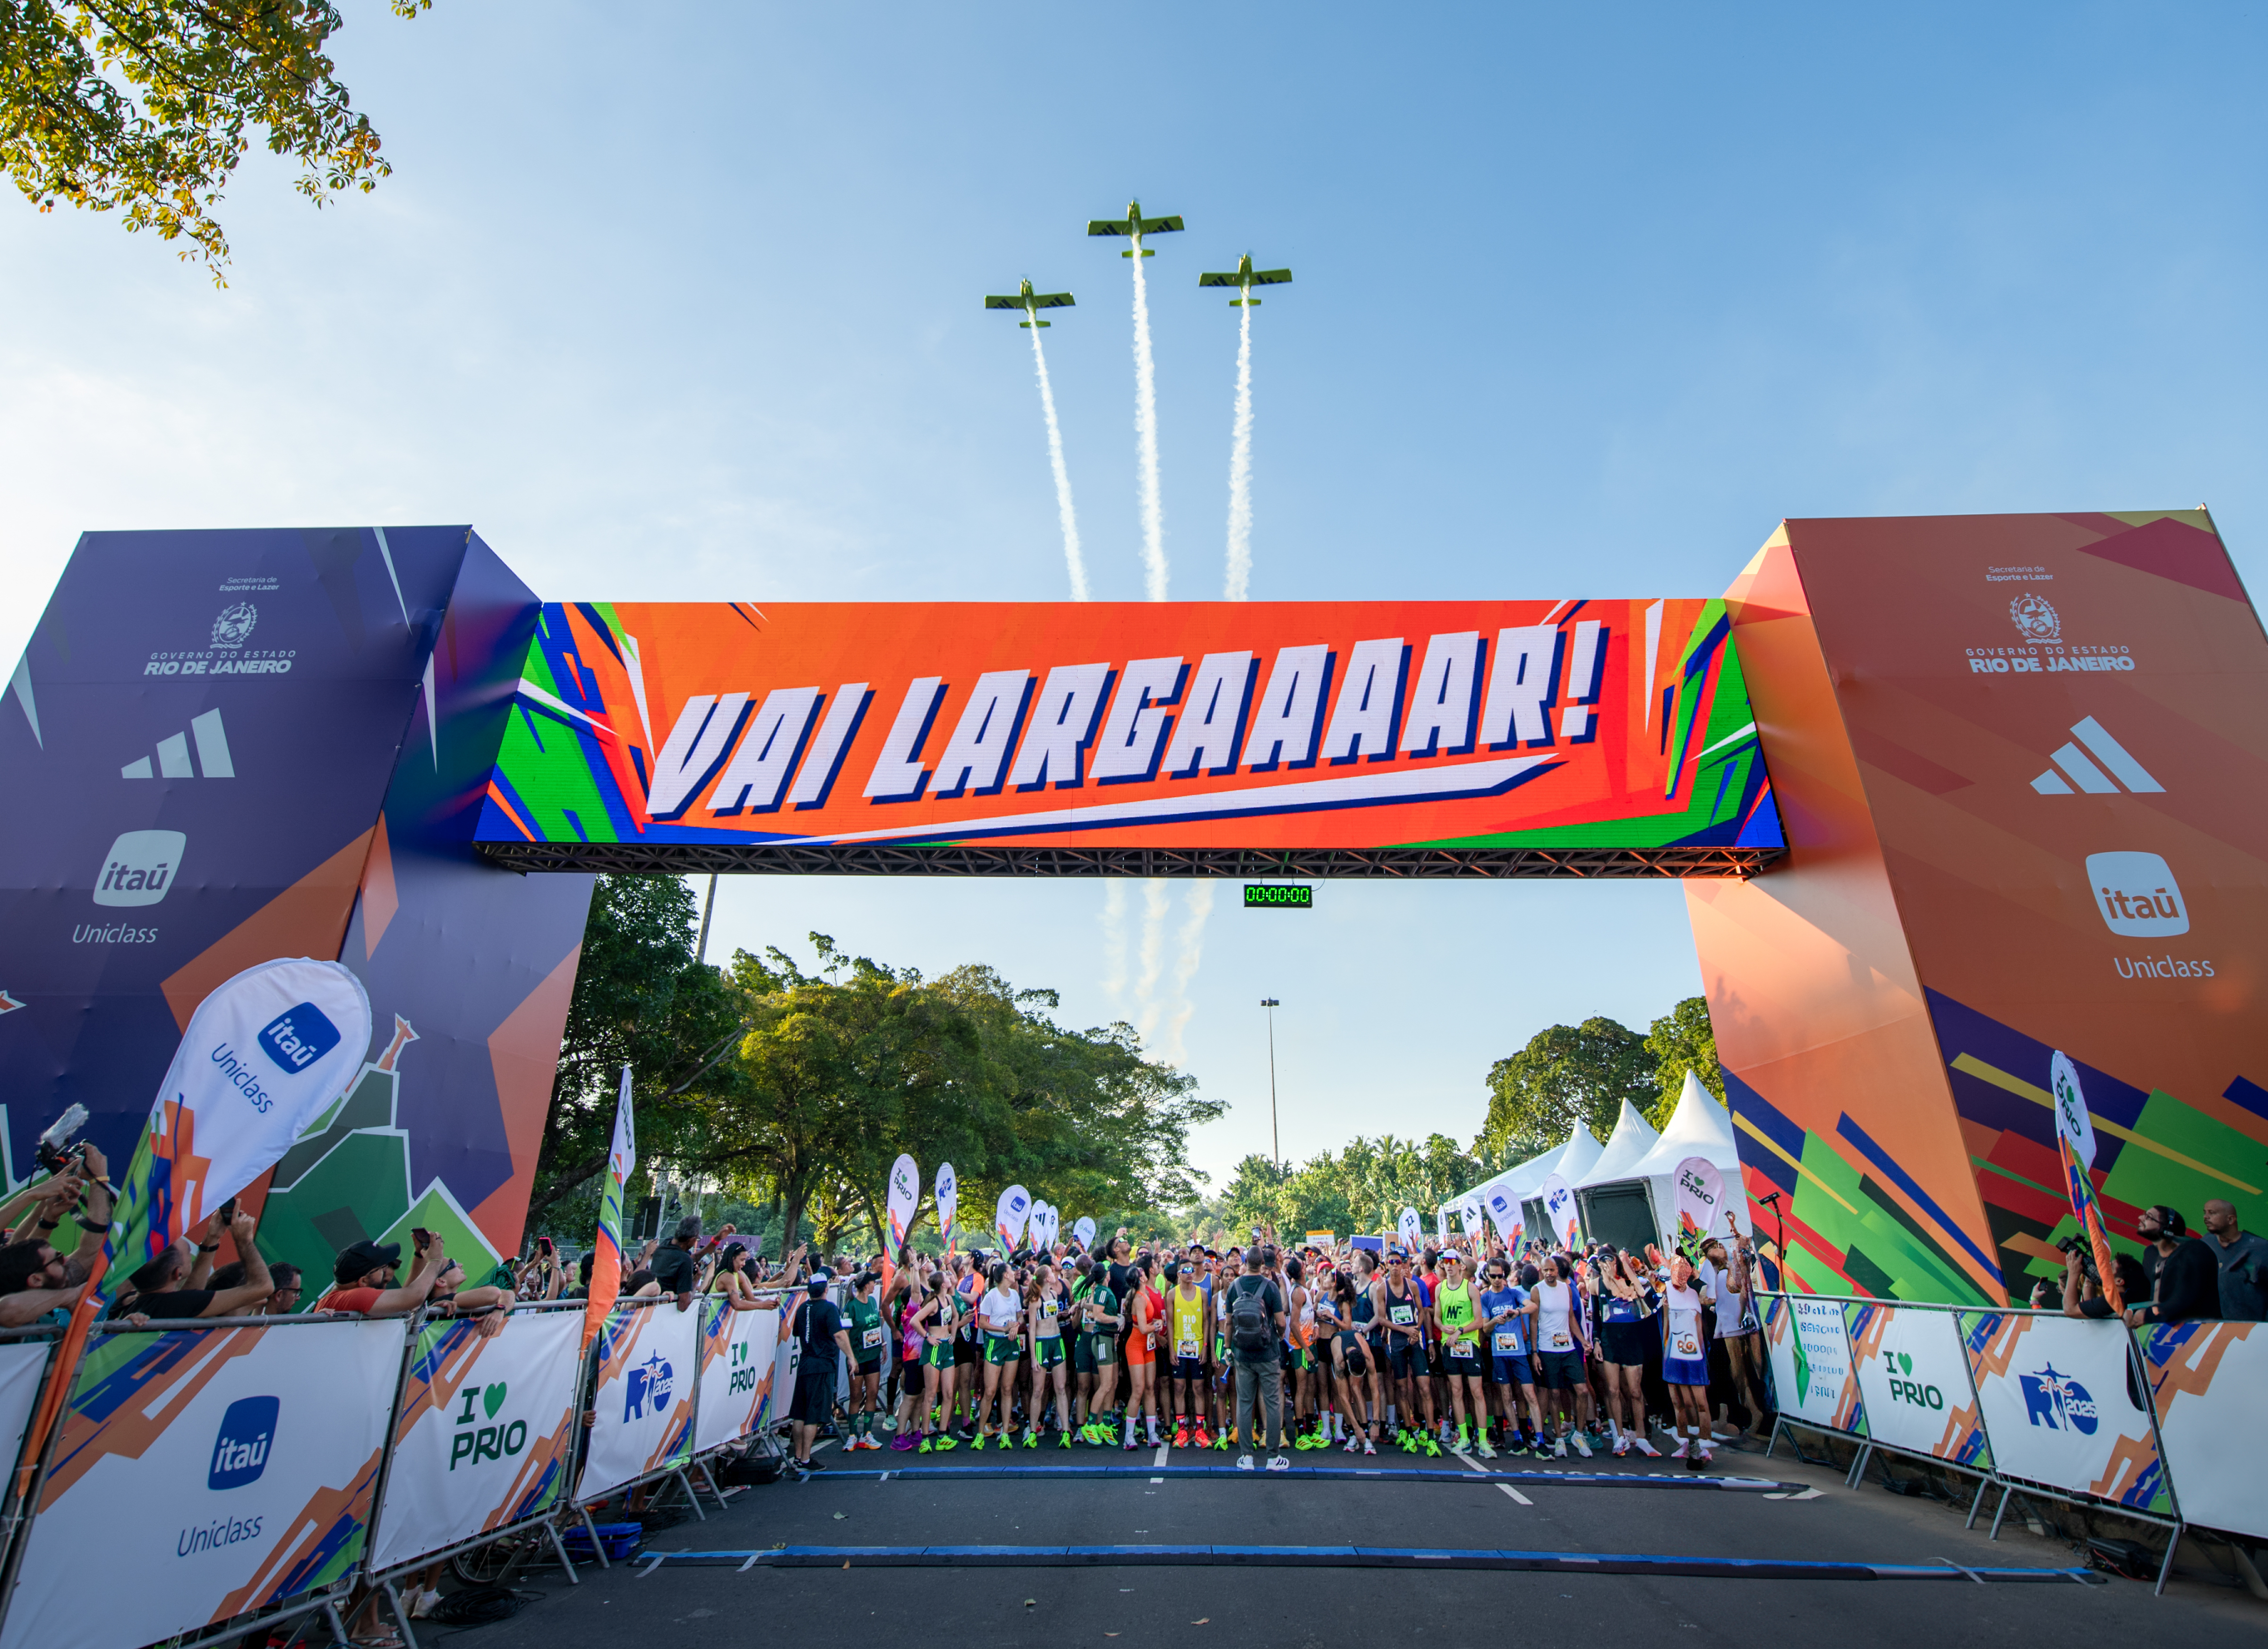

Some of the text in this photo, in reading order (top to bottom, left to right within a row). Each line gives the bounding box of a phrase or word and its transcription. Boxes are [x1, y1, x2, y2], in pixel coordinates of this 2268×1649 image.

[150, 650, 296, 660] GOVERNO DO ESTADO
[1966, 645, 2129, 656] GOVERNO DO ESTADO
[144, 660, 291, 675] RIO DE JANEIRO
[1969, 656, 2135, 673] RIO DE JANEIRO
[645, 619, 1605, 817] VAI LARGAAAAR!
[101, 862, 169, 891] itaú
[1246, 887, 1309, 902] 00:00:00
[2102, 887, 2179, 919] itaú
[72, 924, 158, 944] Uniclass
[2114, 955, 2214, 979] Uniclass
[268, 1018, 314, 1066] itaú
[212, 1043, 273, 1114] Uniclass
[2057, 1081, 2081, 1136] PRIO
[1683, 1169, 1693, 1180] I
[894, 1177, 912, 1200] PRIO
[1680, 1177, 1714, 1205] PRIO
[1003, 1209, 1018, 1222] Uniclass
[1499, 1210, 1515, 1223] Uniclass
[1183, 1315, 1196, 1324] RIO
[1492, 1305, 1513, 1313] CRAZY
[1183, 1323, 1192, 1332] 5K
[732, 1343, 739, 1366] I
[1883, 1350, 1898, 1374] I
[654, 1377, 673, 1396] 2025
[728, 1366, 755, 1395] PRIO
[1889, 1378, 1943, 1410] PRIO
[456, 1387, 480, 1425] I
[2065, 1398, 2097, 1418] 2025
[214, 1433, 267, 1474] itaú
[450, 1420, 527, 1471] PRIO
[177, 1515, 263, 1557] Uniclass
